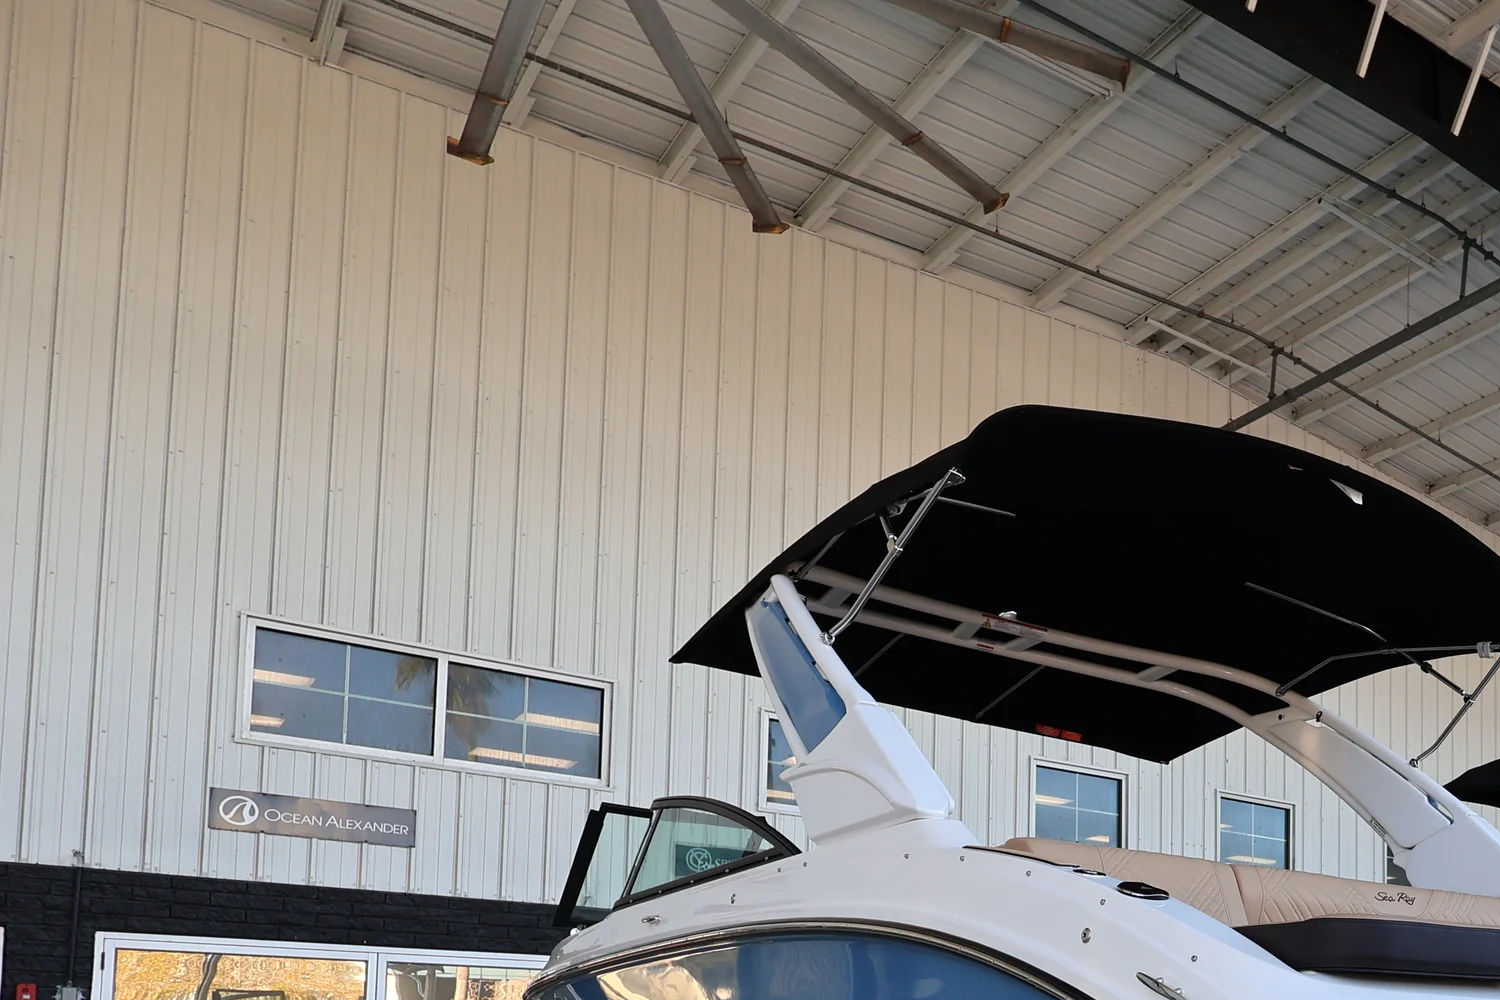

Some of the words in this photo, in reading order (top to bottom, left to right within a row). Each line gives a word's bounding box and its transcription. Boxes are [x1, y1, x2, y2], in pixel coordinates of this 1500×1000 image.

[264, 808, 323, 827] OCEAN
[325, 815, 409, 836] ALEXANDER
[1374, 891, 1396, 902] Sea
[1397, 892, 1416, 906] Ray
